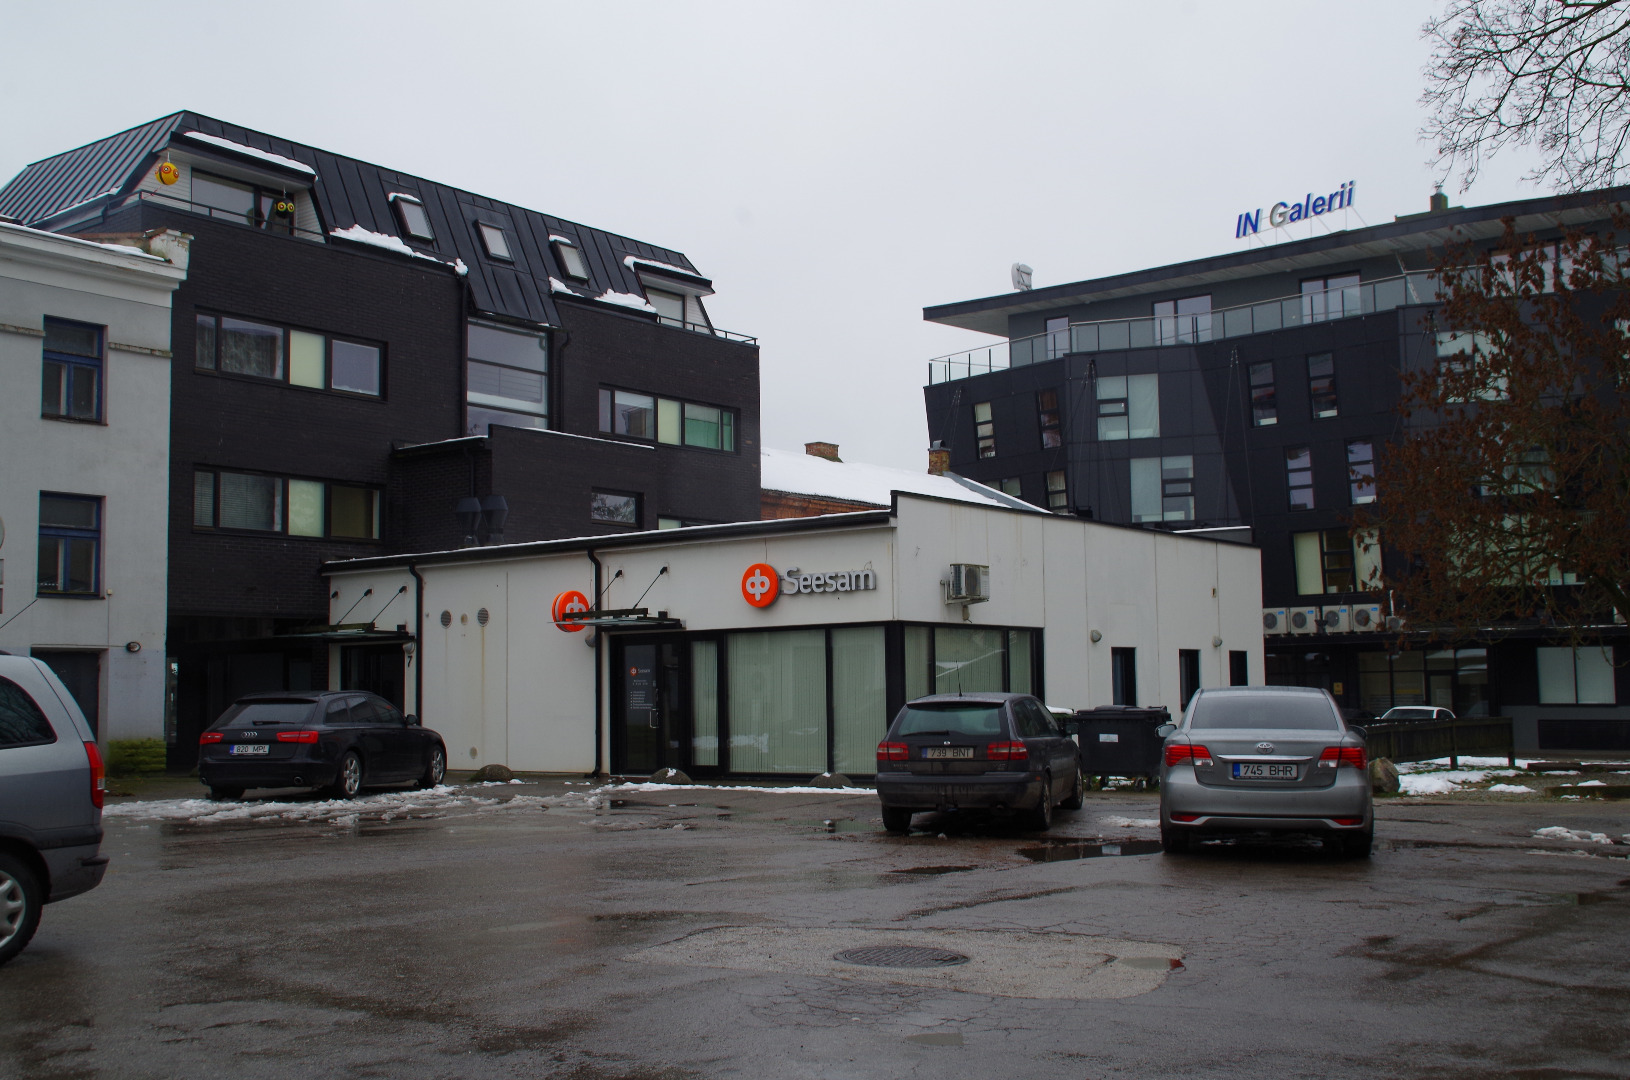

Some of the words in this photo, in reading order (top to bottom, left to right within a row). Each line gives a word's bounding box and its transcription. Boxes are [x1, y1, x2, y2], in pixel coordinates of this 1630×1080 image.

[1236, 208, 1262, 238] IN
[1270, 180, 1355, 228] Galerii
[783, 566, 876, 595] Seesam
[407, 655, 413, 668] 7
[236, 745, 249, 753] 820
[252, 745, 267, 753] MPL
[931, 748, 947, 757] 739
[952, 748, 970, 757] BNT
[1243, 765, 1263, 776] 745
[1269, 765, 1293, 776] BHR
